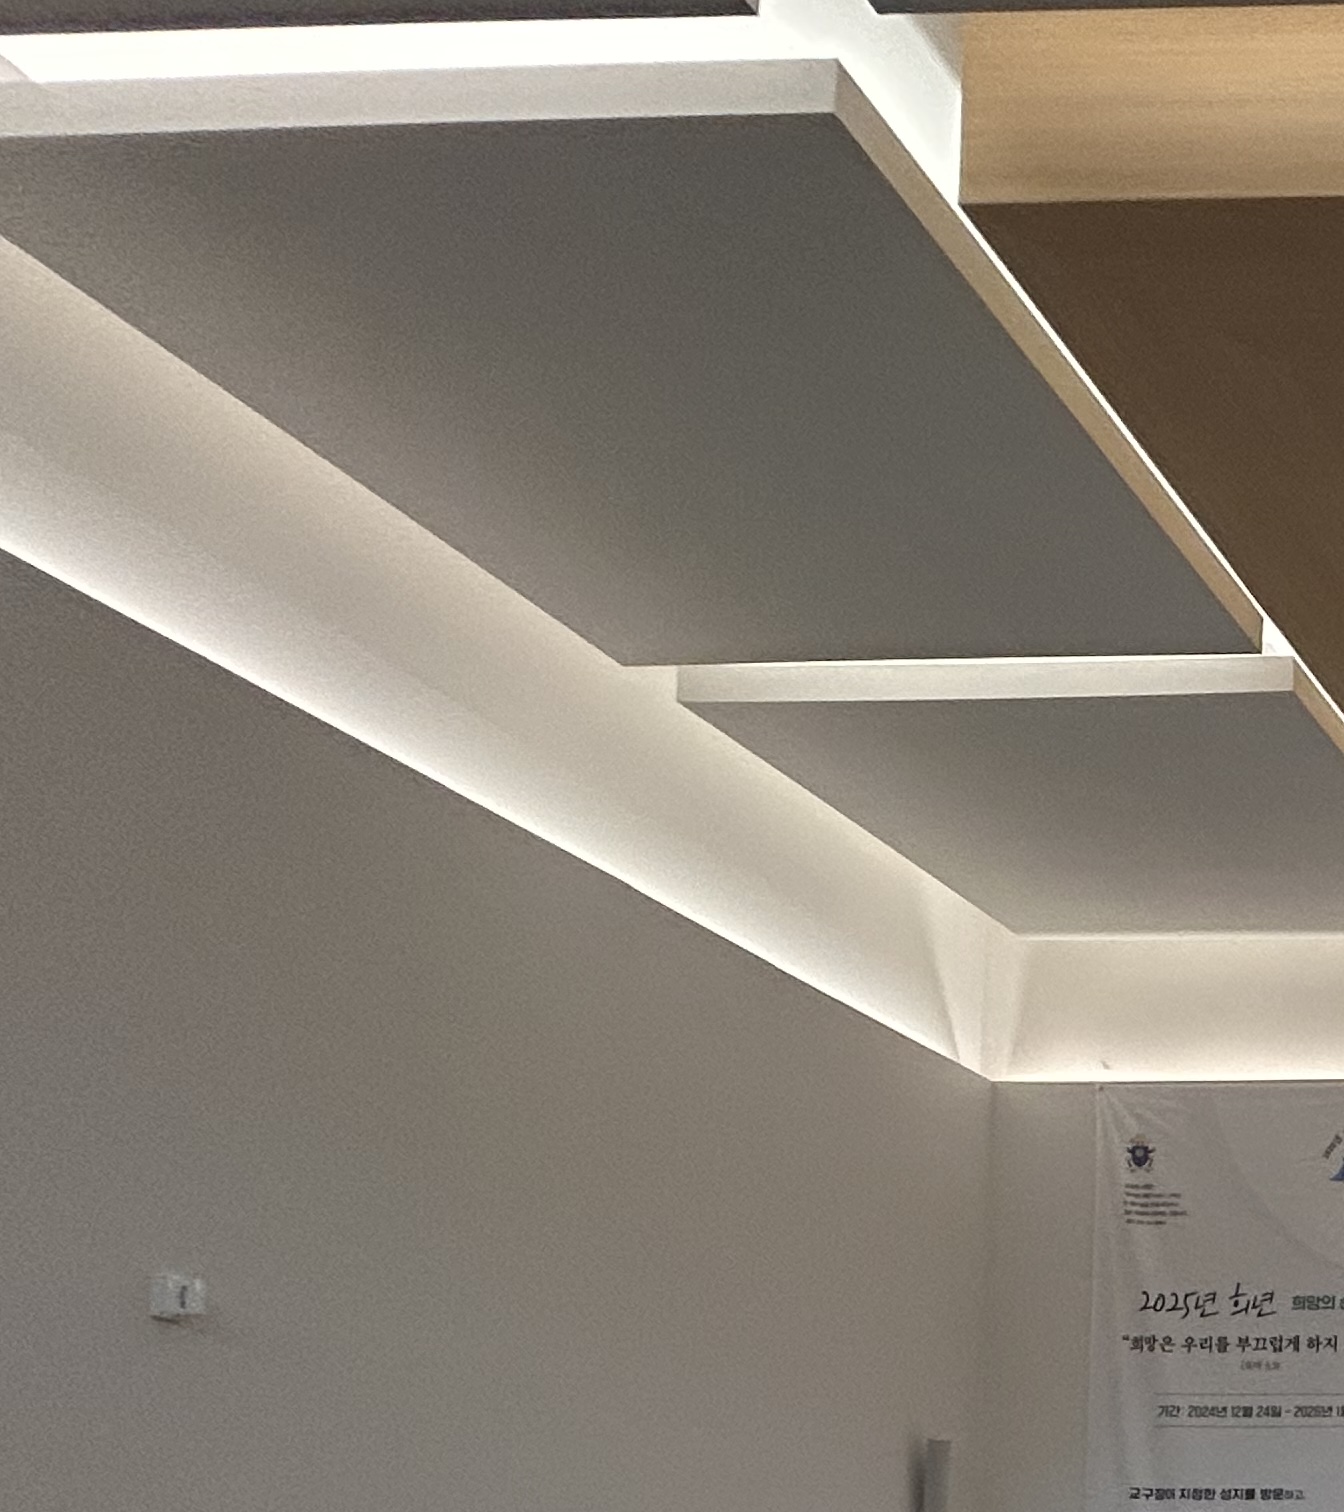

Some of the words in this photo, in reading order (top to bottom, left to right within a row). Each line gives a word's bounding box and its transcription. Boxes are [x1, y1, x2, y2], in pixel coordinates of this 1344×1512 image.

[1138, 1291, 1220, 1319] 2025년
[1228, 1282, 1278, 1318] 희년
[1291, 1295, 1336, 1311] 희망의
[1180, 1335, 1231, 1353] 우리를
[1235, 1334, 1301, 1353] 부끄럽게
[1306, 1334, 1338, 1353] 하지
[1179, 1487, 1216, 1501] 지정한
[1219, 1487, 1256, 1501] 성지를
